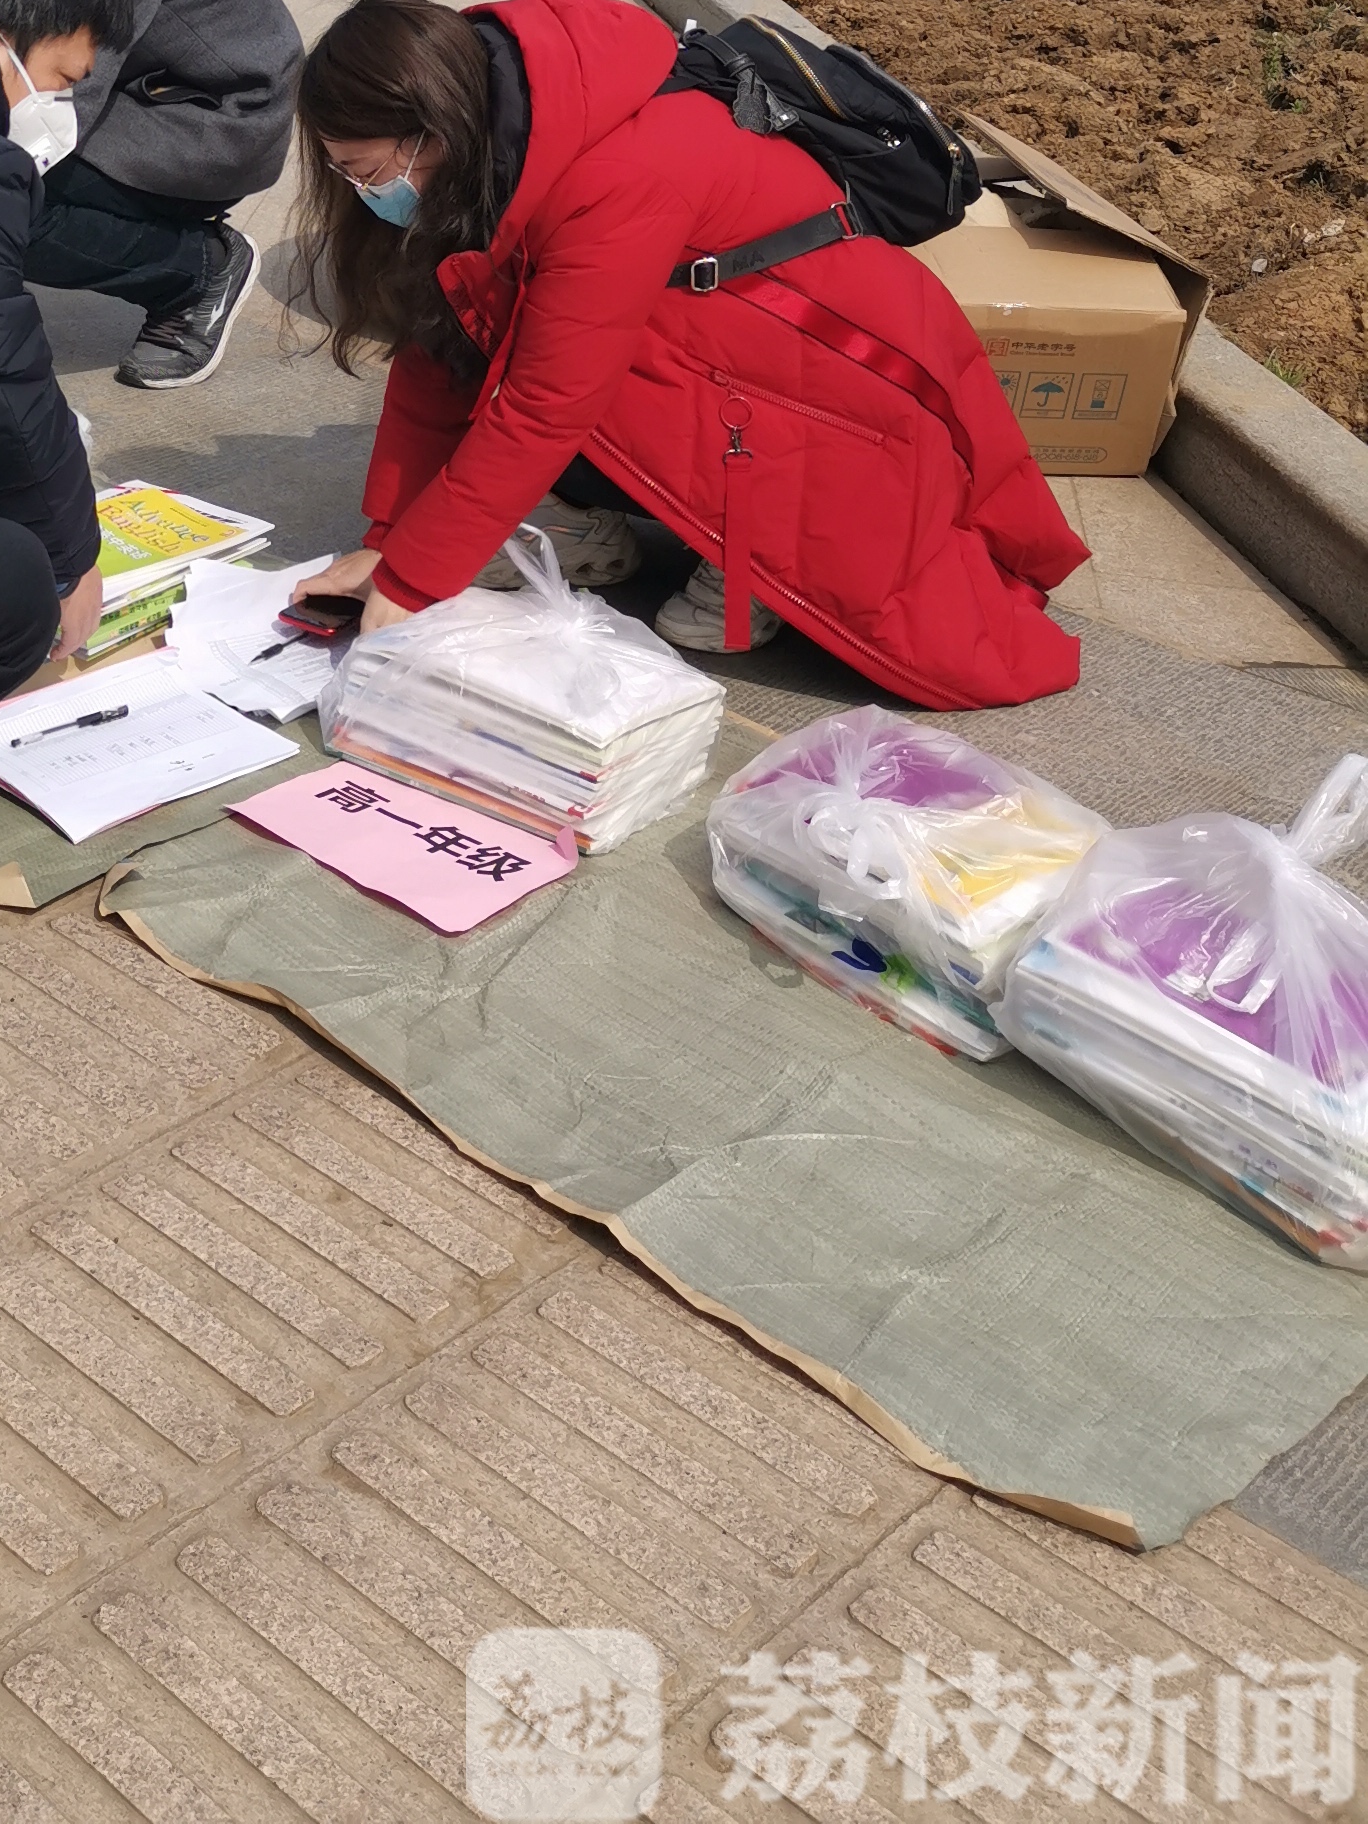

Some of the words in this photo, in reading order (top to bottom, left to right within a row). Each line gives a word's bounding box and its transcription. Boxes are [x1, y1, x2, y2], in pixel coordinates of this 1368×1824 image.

[1011, 341, 1077, 352] 中华老字号
[313, 778, 532, 883] 高一年级
